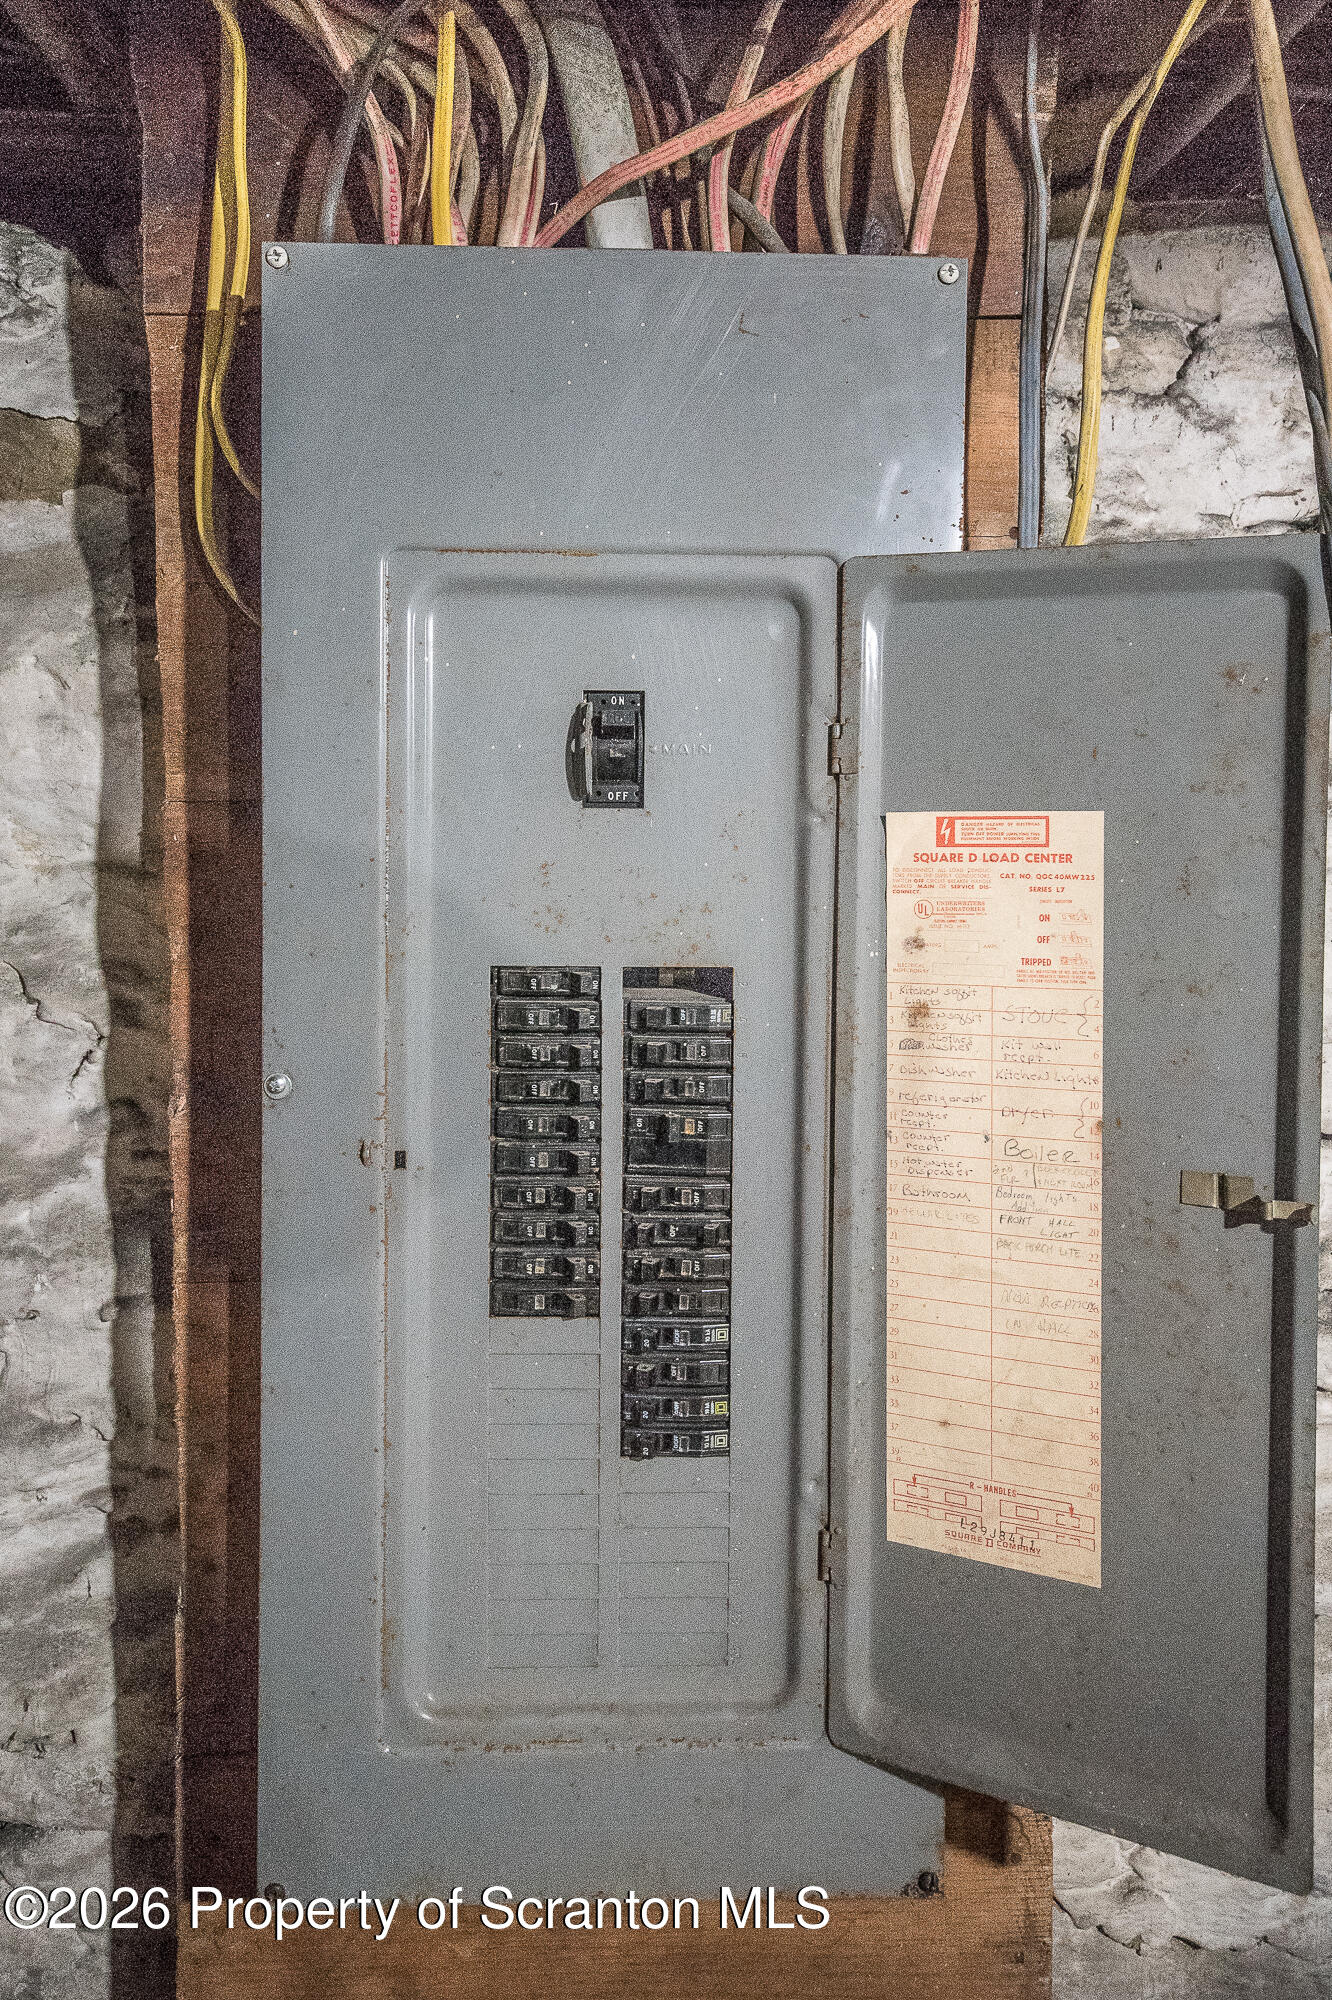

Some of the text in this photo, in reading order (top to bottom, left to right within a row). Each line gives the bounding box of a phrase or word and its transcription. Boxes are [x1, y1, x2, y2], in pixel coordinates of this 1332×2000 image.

[611, 696, 625, 706] ON
[608, 792, 628, 800] OFF
[914, 852, 1073, 864] SQUARE D LOAD CENTER
[918, 904, 929, 916] UL
[1021, 958, 1052, 966] TRIPPED
[1094, 1000, 1100, 1008] 2
[890, 1016, 894, 1024] 3
[1094, 1051, 1100, 1060] 6
[1090, 1102, 1099, 1110] 10
[890, 1112, 896, 1120] 11
[1090, 1152, 1100, 1160] 14
[890, 1160, 898, 1168] 15
[1090, 1178, 1100, 1186] 16
[890, 1184, 898, 1192] 17
[1090, 1203, 1098, 1211] 18
[891, 1207, 898, 1216] 19
[1000, 1214, 1076, 1226] FRONT HALL
[890, 1232, 898, 1240] 21
[1088, 1228, 1099, 1236] 20
[1088, 1254, 1098, 1262] 22
[1089, 1280, 1098, 1288] 24
[1089, 1330, 1100, 1338] 28
[890, 1351, 898, 1360] 31
[1089, 1356, 1100, 1364] 30
[1090, 1381, 1099, 1390] 32
[1089, 1406, 1100, 1416] 34
[890, 1423, 899, 1431] 37
[1089, 1432, 1100, 1441] 36
[1088, 1457, 1100, 1466] 38
[970, 1482, 974, 1490] R
[984, 1484, 1016, 1498] HANDLES
[1089, 1484, 1099, 1492] 40
[944, 1530, 982, 1542] SQUARE
[997, 1540, 1040, 1554] COMPANY
